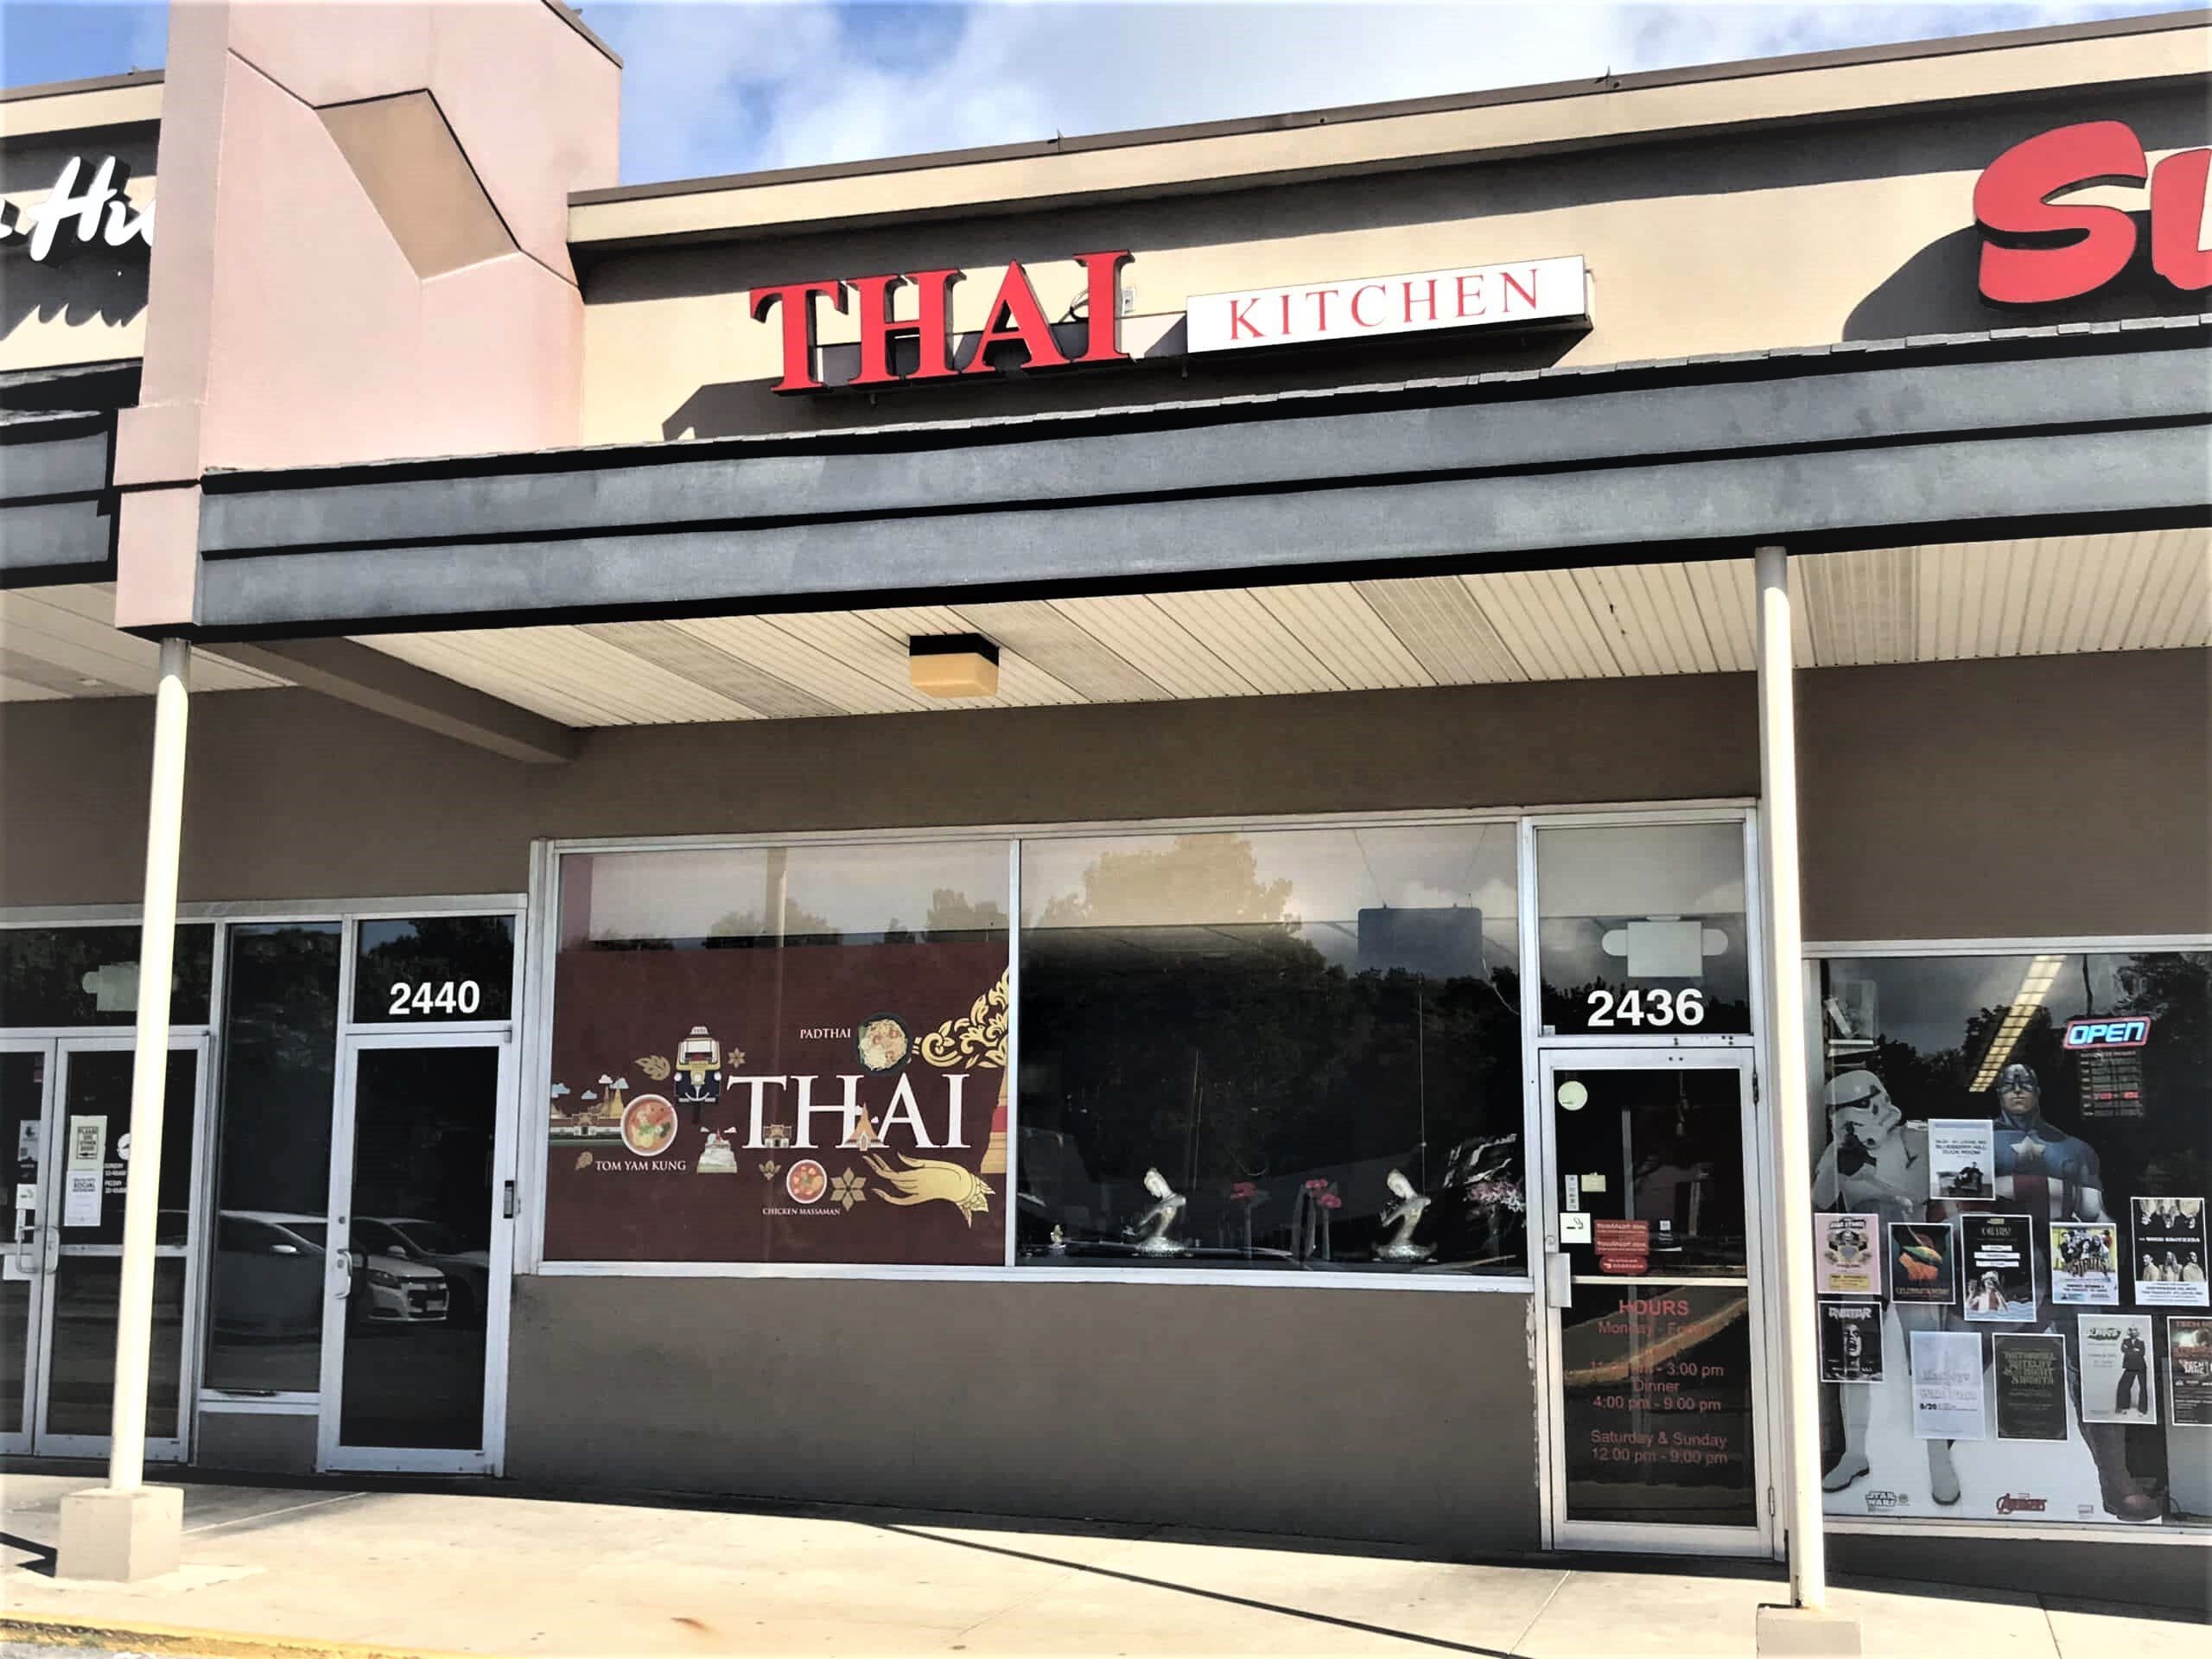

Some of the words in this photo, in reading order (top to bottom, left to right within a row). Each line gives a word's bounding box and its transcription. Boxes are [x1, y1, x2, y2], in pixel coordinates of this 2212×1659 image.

[749, 250, 1131, 394] THAI
[1230, 269, 1538, 340] KITCHEN
[388, 980, 480, 1014] 2440
[1586, 988, 1705, 1027] 2436
[800, 1027, 851, 1040] PADTHAI
[2069, 1021, 2145, 1045] OPEN
[727, 1071, 971, 1149] THAI
[595, 1160, 622, 1172] TOM
[624, 1160, 651, 1172] YAM
[652, 1160, 686, 1172] KUNG
[799, 1208, 841, 1217] MASSAMAN
[1618, 1300, 1690, 1316] HOURS
[1599, 1321, 1654, 1338] Monday
[1666, 1363, 1697, 1376] 3:00
[1701, 1366, 1725, 1379] pm
[1633, 1379, 1680, 1392] Dinner
[1592, 1395, 1624, 1409] 4:00
[1628, 1399, 1651, 1411] pm
[1663, 1398, 1694, 1410] 9:00
[1699, 1400, 1722, 1413] pm
[1591, 1430, 1654, 1446] Saturday
[1658, 1432, 1669, 1445] &
[1673, 1432, 1728, 1449] Sunday
[1592, 1448, 1630, 1461] 12:00
[1634, 1451, 1656, 1464] pm
[1670, 1450, 1702, 1464] 9:00
[1706, 1452, 1729, 1466] pm
